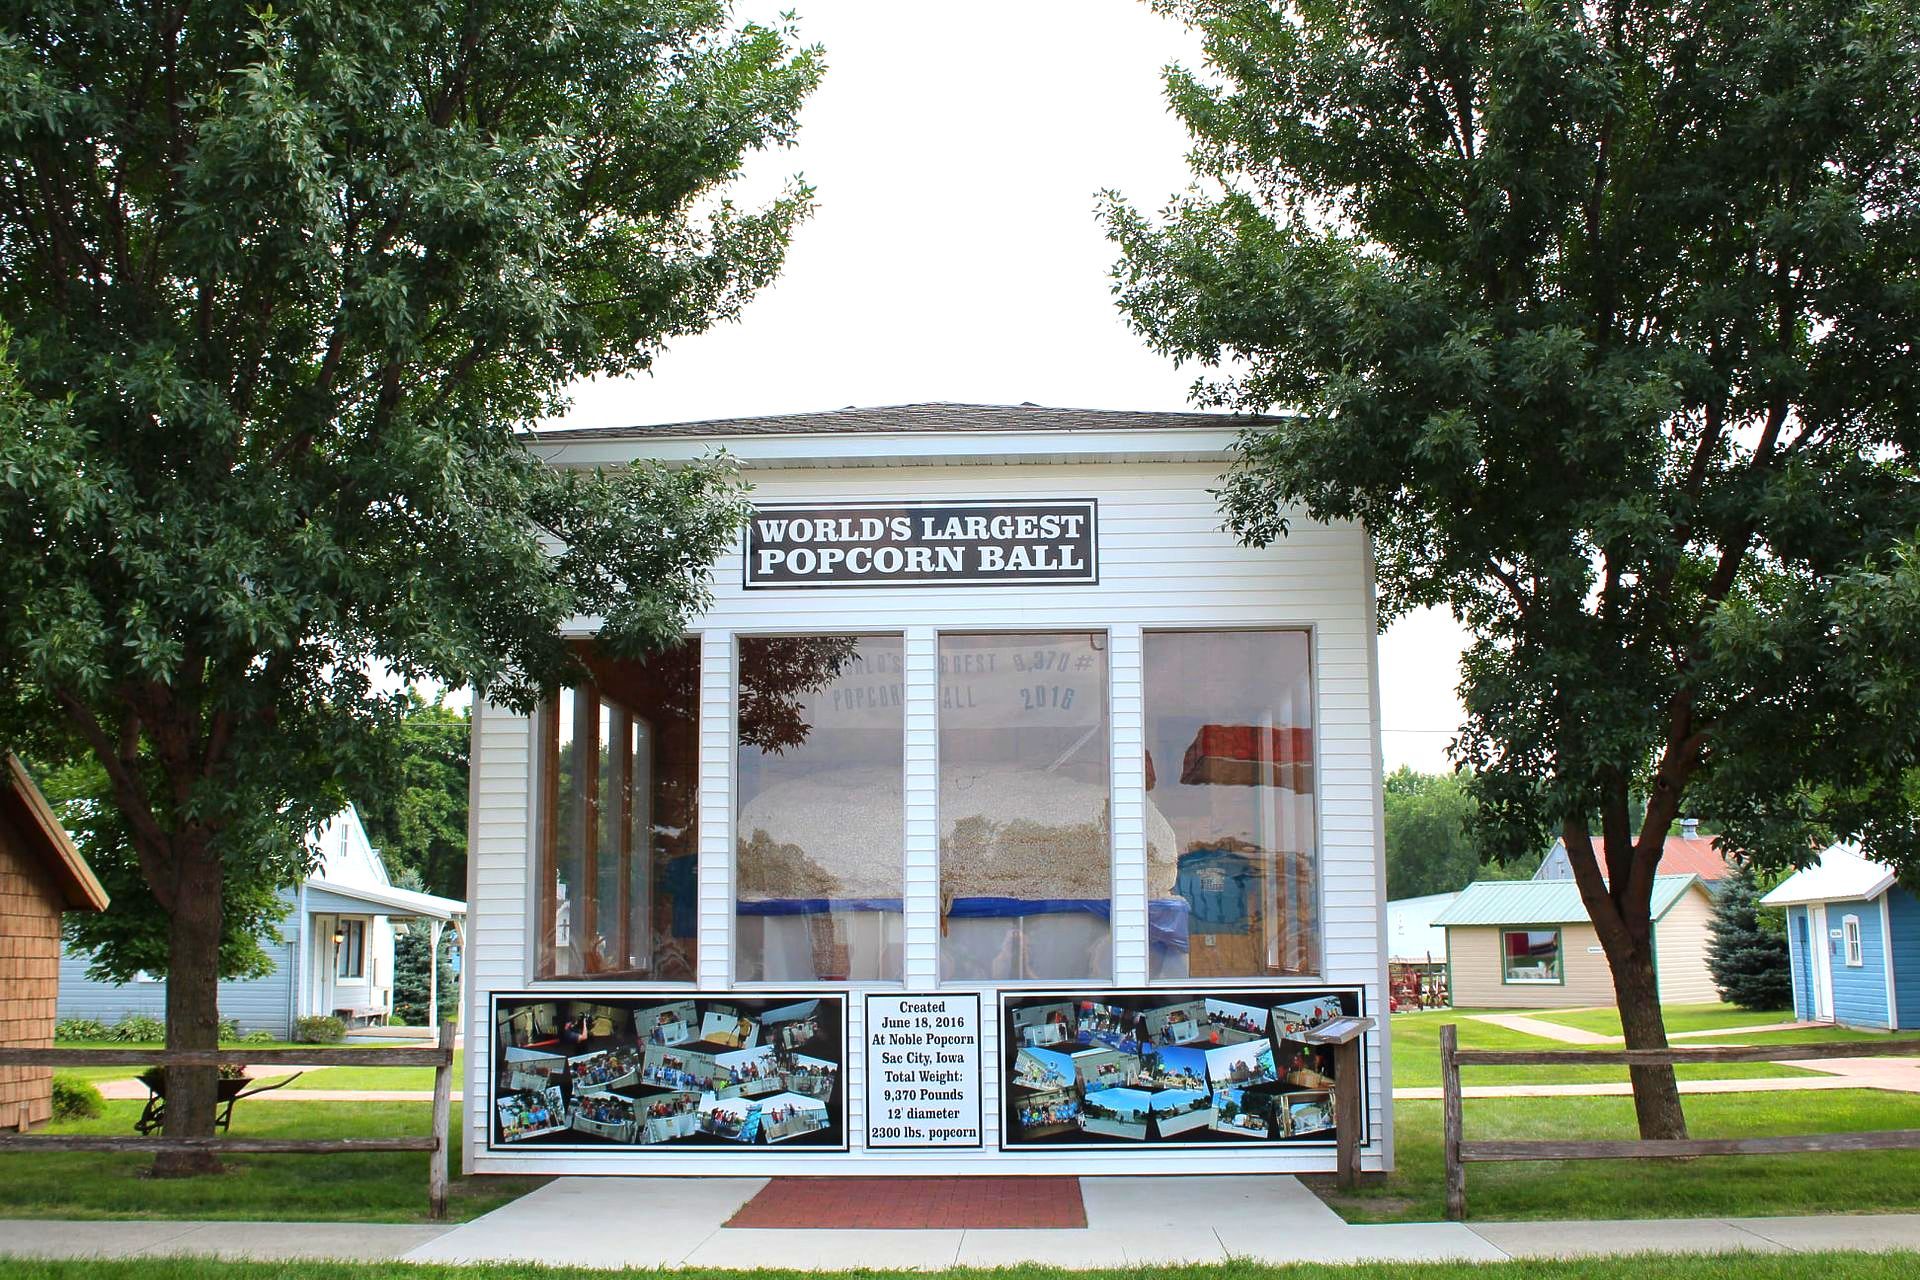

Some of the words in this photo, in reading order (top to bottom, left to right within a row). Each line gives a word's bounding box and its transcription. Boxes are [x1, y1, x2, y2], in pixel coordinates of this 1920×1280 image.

[758, 516, 912, 544] WORLD'S
[921, 514, 1085, 541] LARGEST
[757, 547, 966, 575] POPCORN
[977, 544, 1085, 572] BALL
[832, 683, 904, 712] POPCOR
[1020, 685, 1075, 710] 2016
[899, 1001, 946, 1013] Created
[881, 1017, 911, 1029] June
[915, 1017, 932, 1029] 18,
[935, 1017, 965, 1028] 2016
[872, 1034, 886, 1046] At
[889, 1034, 923, 1046] Noble
[926, 1034, 975, 1048] Popcorn
[882, 1052, 903, 1064] Sac
[906, 1052, 933, 1067] City,
[936, 1052, 965, 1064] Iowa
[884, 1071, 916, 1083] Total
[919, 1071, 964, 1086] Weight:
[884, 1090, 917, 1103] 9,370
[919, 1089, 964, 1101] Pounds
[888, 1108, 904, 1119] 12'
[906, 1107, 960, 1119] diameter
[871, 1127, 901, 1138] 2300
[904, 1126, 926, 1138] lbs.
[928, 1128, 977, 1141] popcorn
